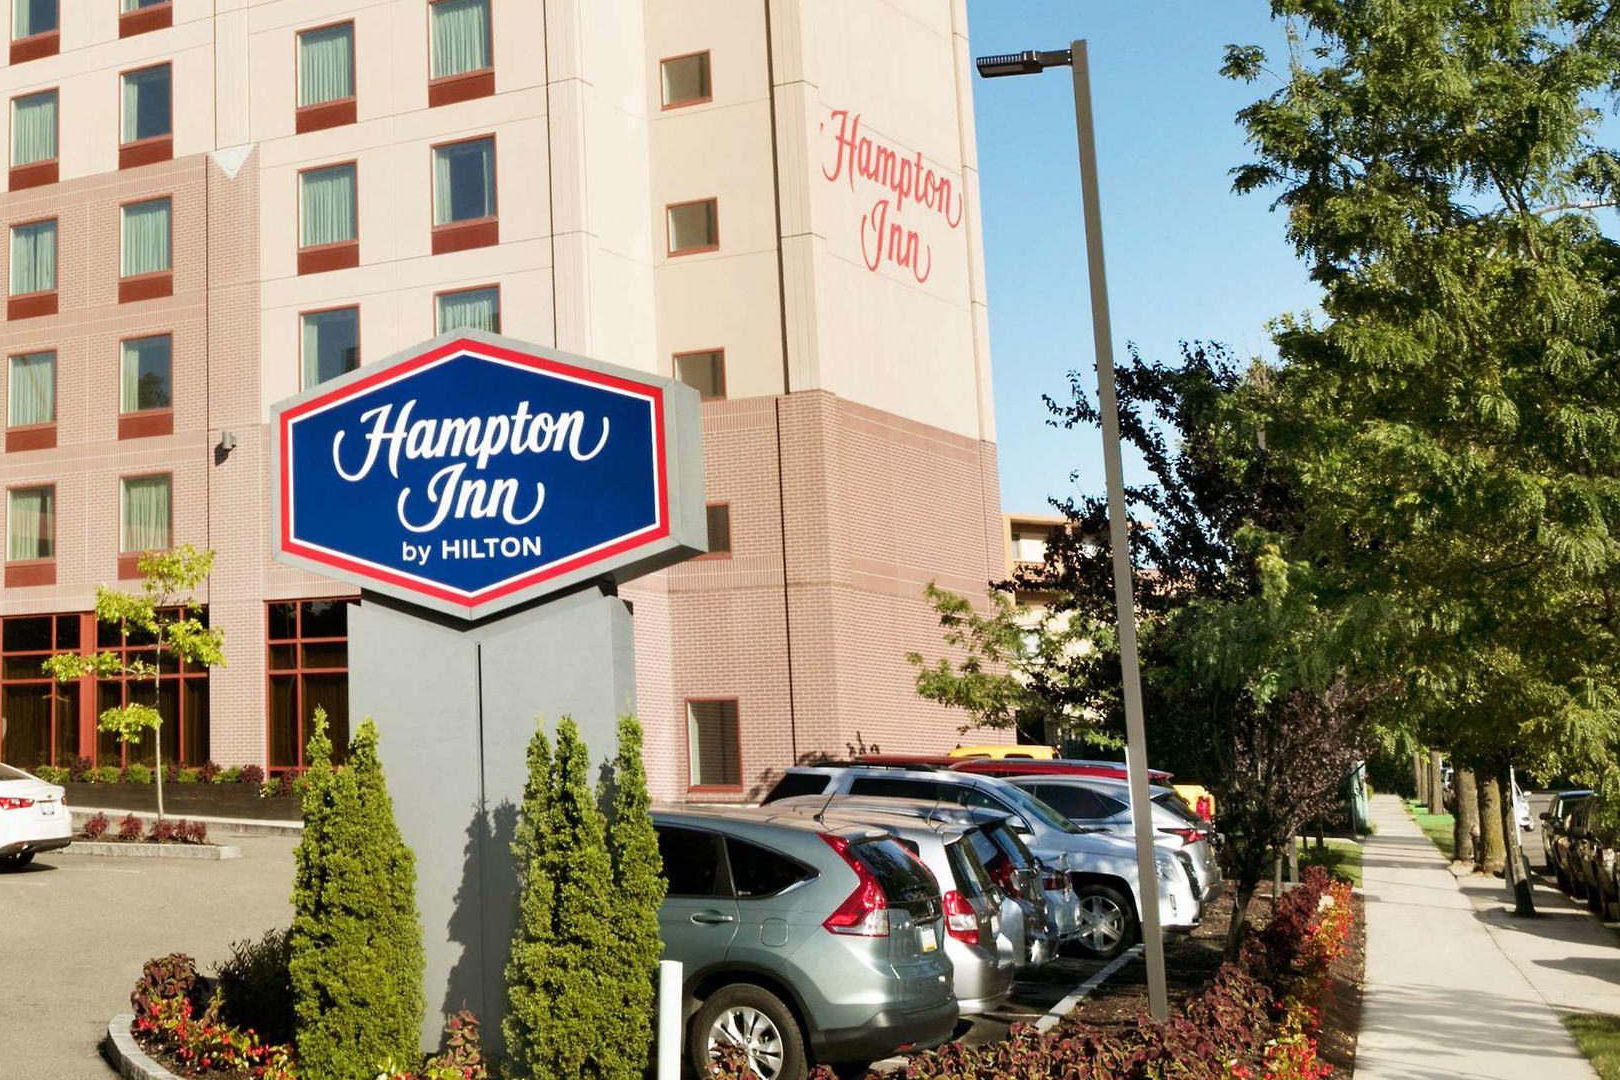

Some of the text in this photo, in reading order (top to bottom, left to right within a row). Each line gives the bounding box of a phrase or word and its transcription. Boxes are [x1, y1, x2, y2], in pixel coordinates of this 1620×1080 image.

[819, 109, 963, 229] Hampton
[860, 198, 931, 284] Inn
[332, 399, 610, 482] Hampton
[397, 462, 545, 533] Inn
[402, 536, 542, 566] by HILTON
